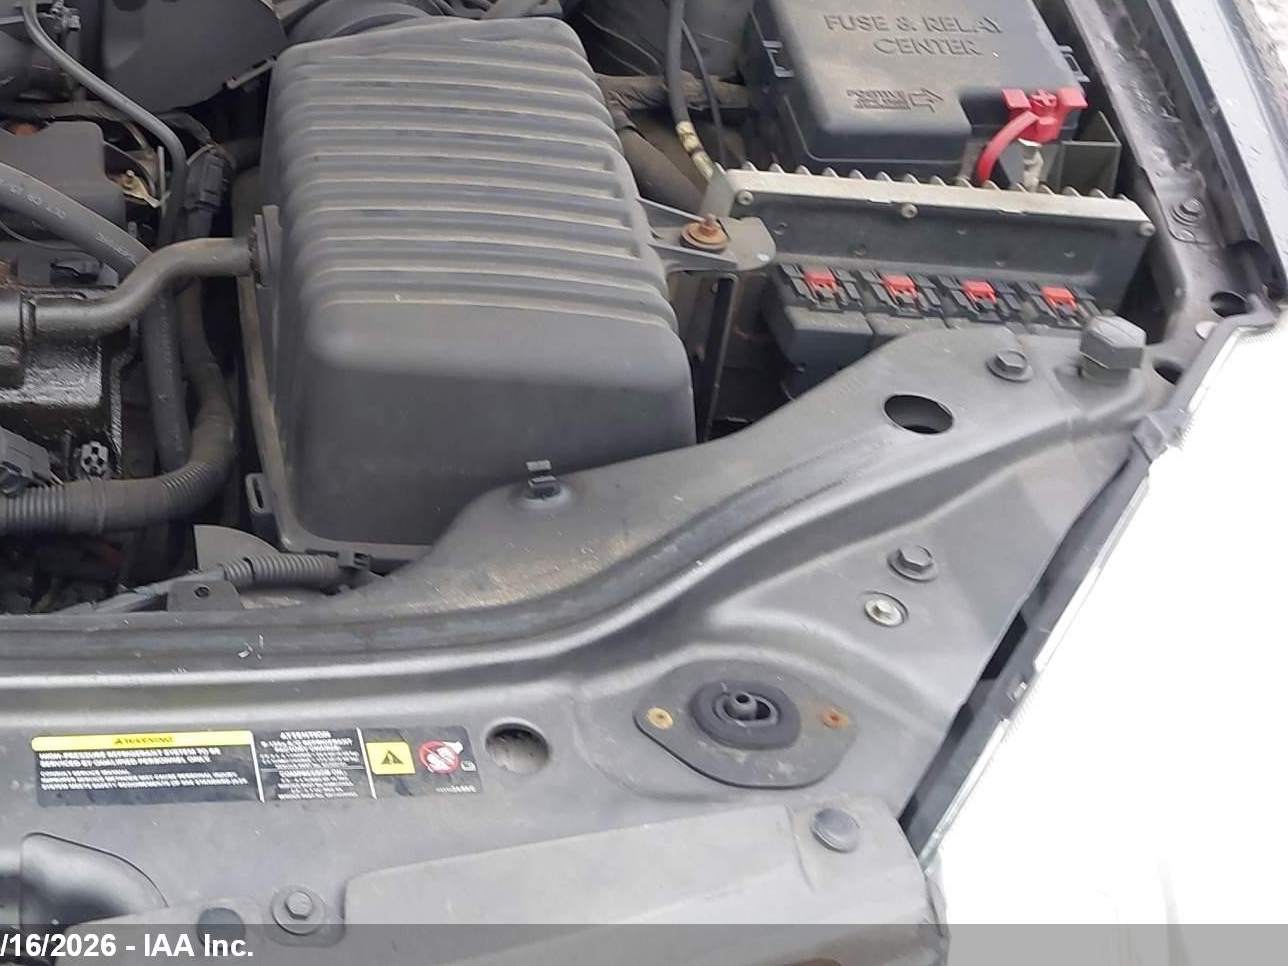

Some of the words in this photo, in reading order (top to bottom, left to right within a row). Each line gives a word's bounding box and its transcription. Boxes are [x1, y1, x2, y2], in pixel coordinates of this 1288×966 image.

[823, 15, 891, 32] FUSE
[896, 15, 917, 32] &
[921, 15, 1003, 33] RELAY
[873, 37, 984, 56] CENTER
[280, 730, 332, 740] ATTENTION
